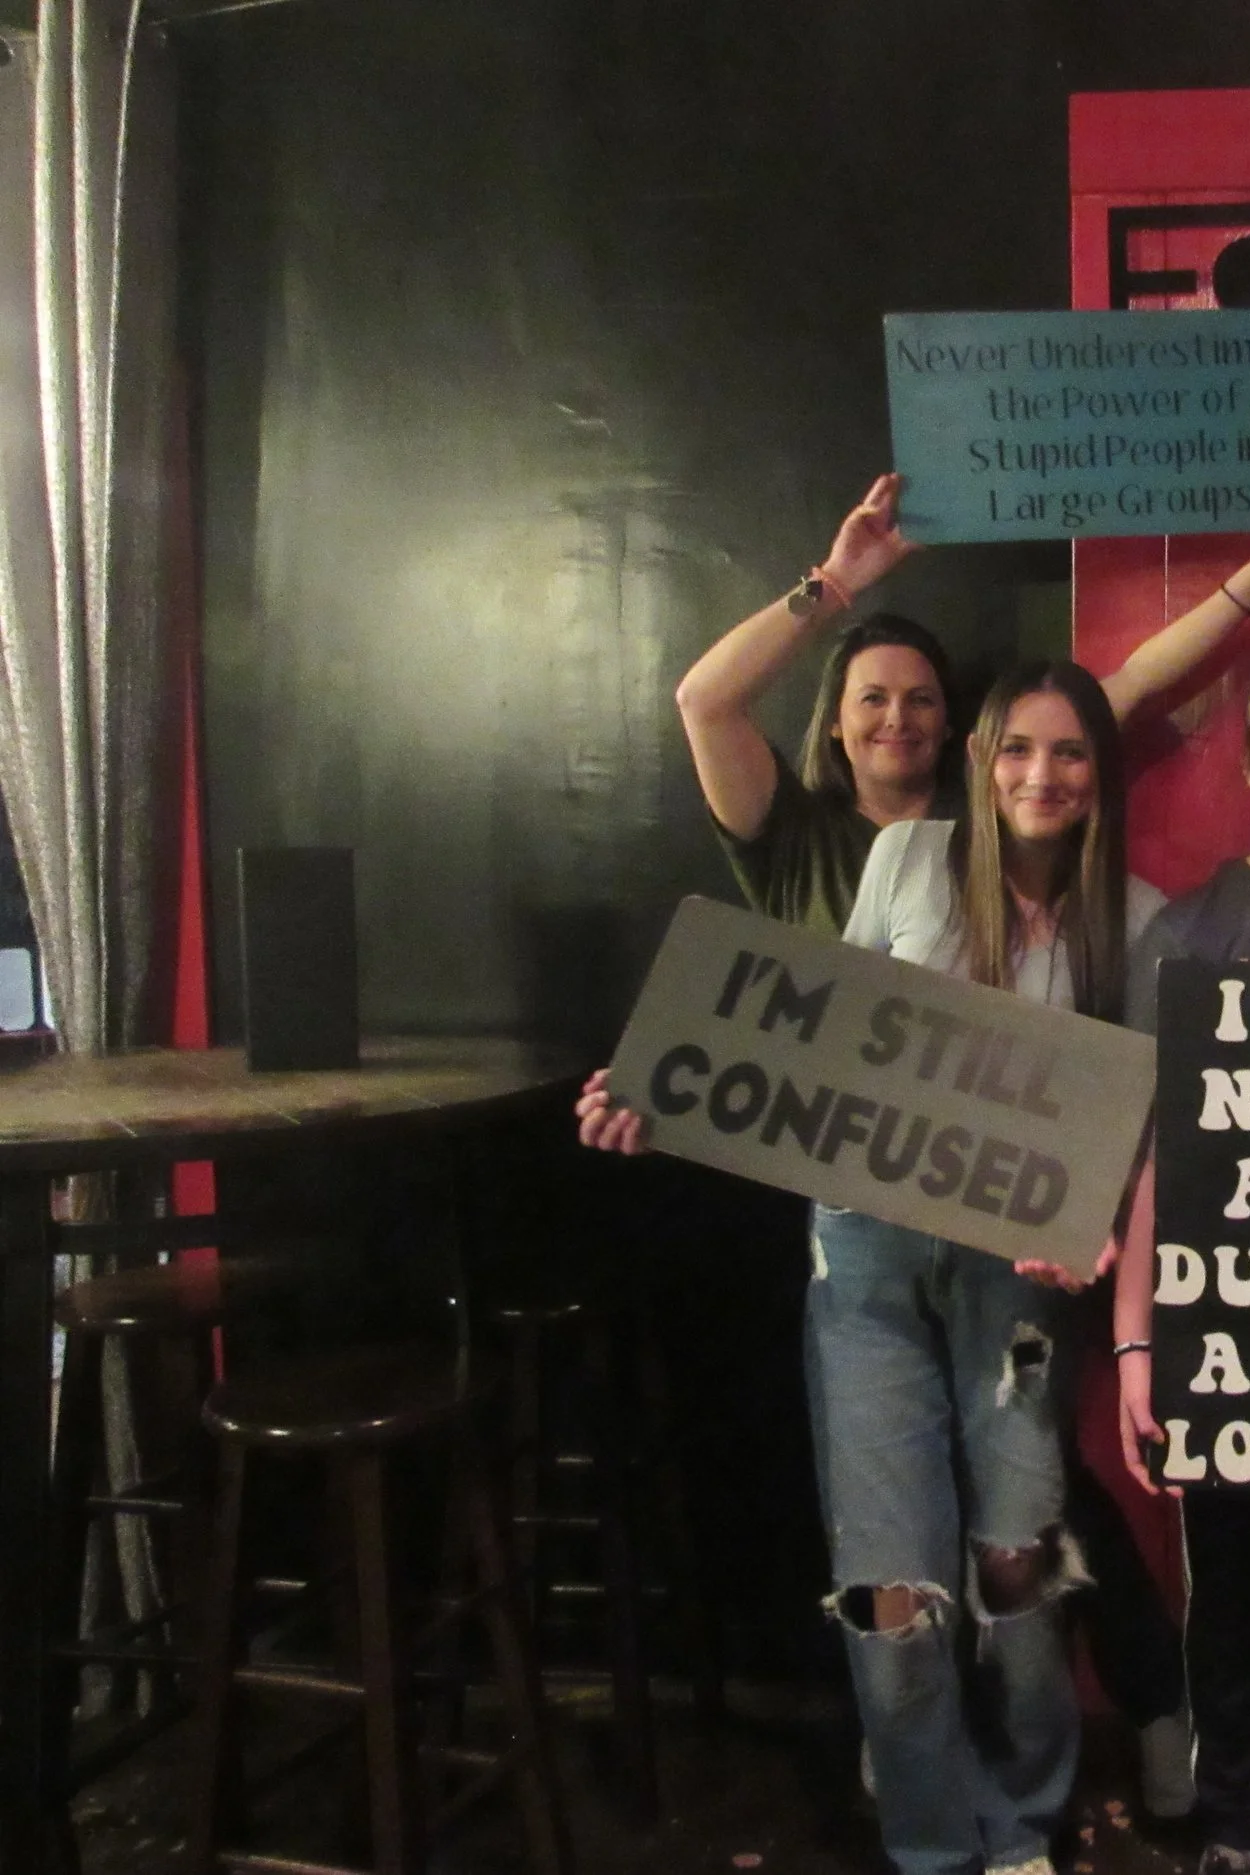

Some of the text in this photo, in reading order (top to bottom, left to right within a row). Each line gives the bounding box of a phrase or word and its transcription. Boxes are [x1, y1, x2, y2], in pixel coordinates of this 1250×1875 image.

[896, 337, 1019, 374] Never
[987, 378, 1243, 422] the Power of
[968, 432, 1097, 477] Stupid
[1104, 429, 1226, 473] People
[988, 488, 1106, 528] Large
[714, 950, 1063, 1120] I'M STILL
[649, 1044, 1070, 1228] CONFUSED
